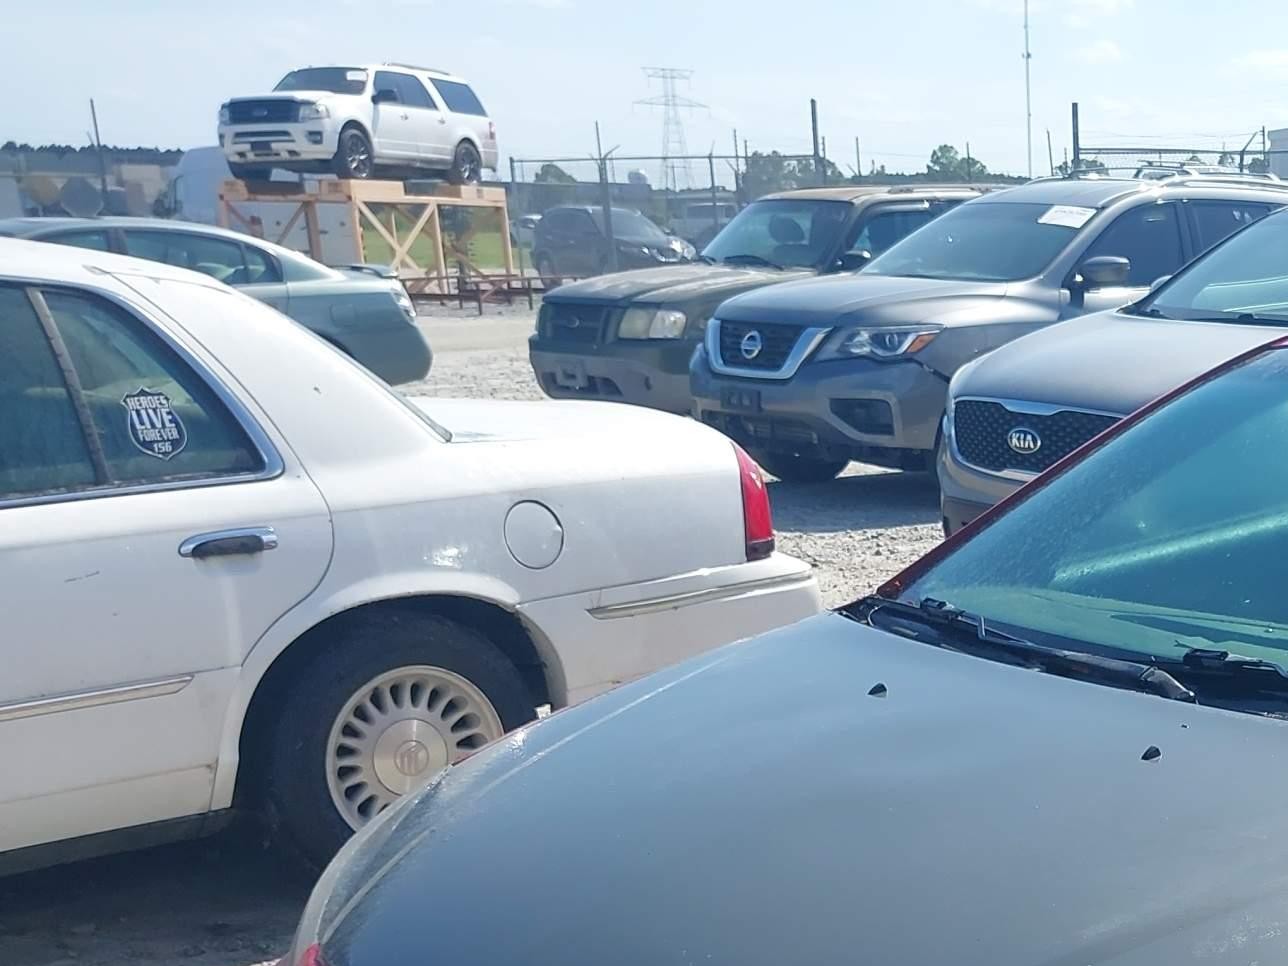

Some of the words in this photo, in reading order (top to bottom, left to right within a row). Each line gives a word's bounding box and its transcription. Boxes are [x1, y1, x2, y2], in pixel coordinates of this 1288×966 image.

[126, 395, 169, 410] HEROES
[130, 408, 176, 429] LIVE
[138, 427, 180, 442] FOREVER
[1011, 432, 1035, 449] KIA
[153, 441, 173, 453] 156
